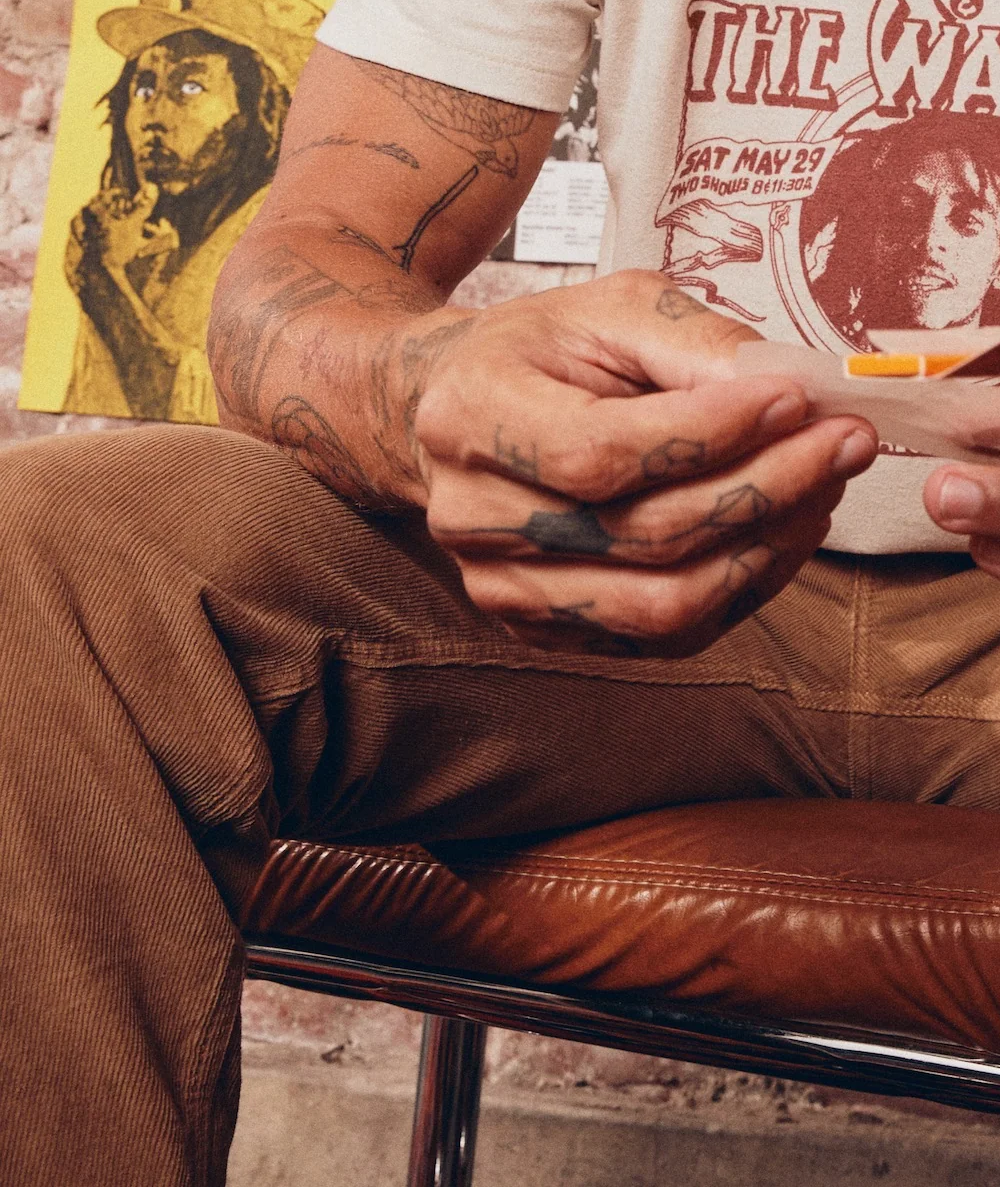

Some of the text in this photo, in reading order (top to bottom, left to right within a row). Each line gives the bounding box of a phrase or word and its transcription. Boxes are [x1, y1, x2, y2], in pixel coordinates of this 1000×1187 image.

[679, 145, 827, 179] SAT MAY 29
[667, 175, 701, 205] TWO
[700, 174, 750, 197] SHOWS
